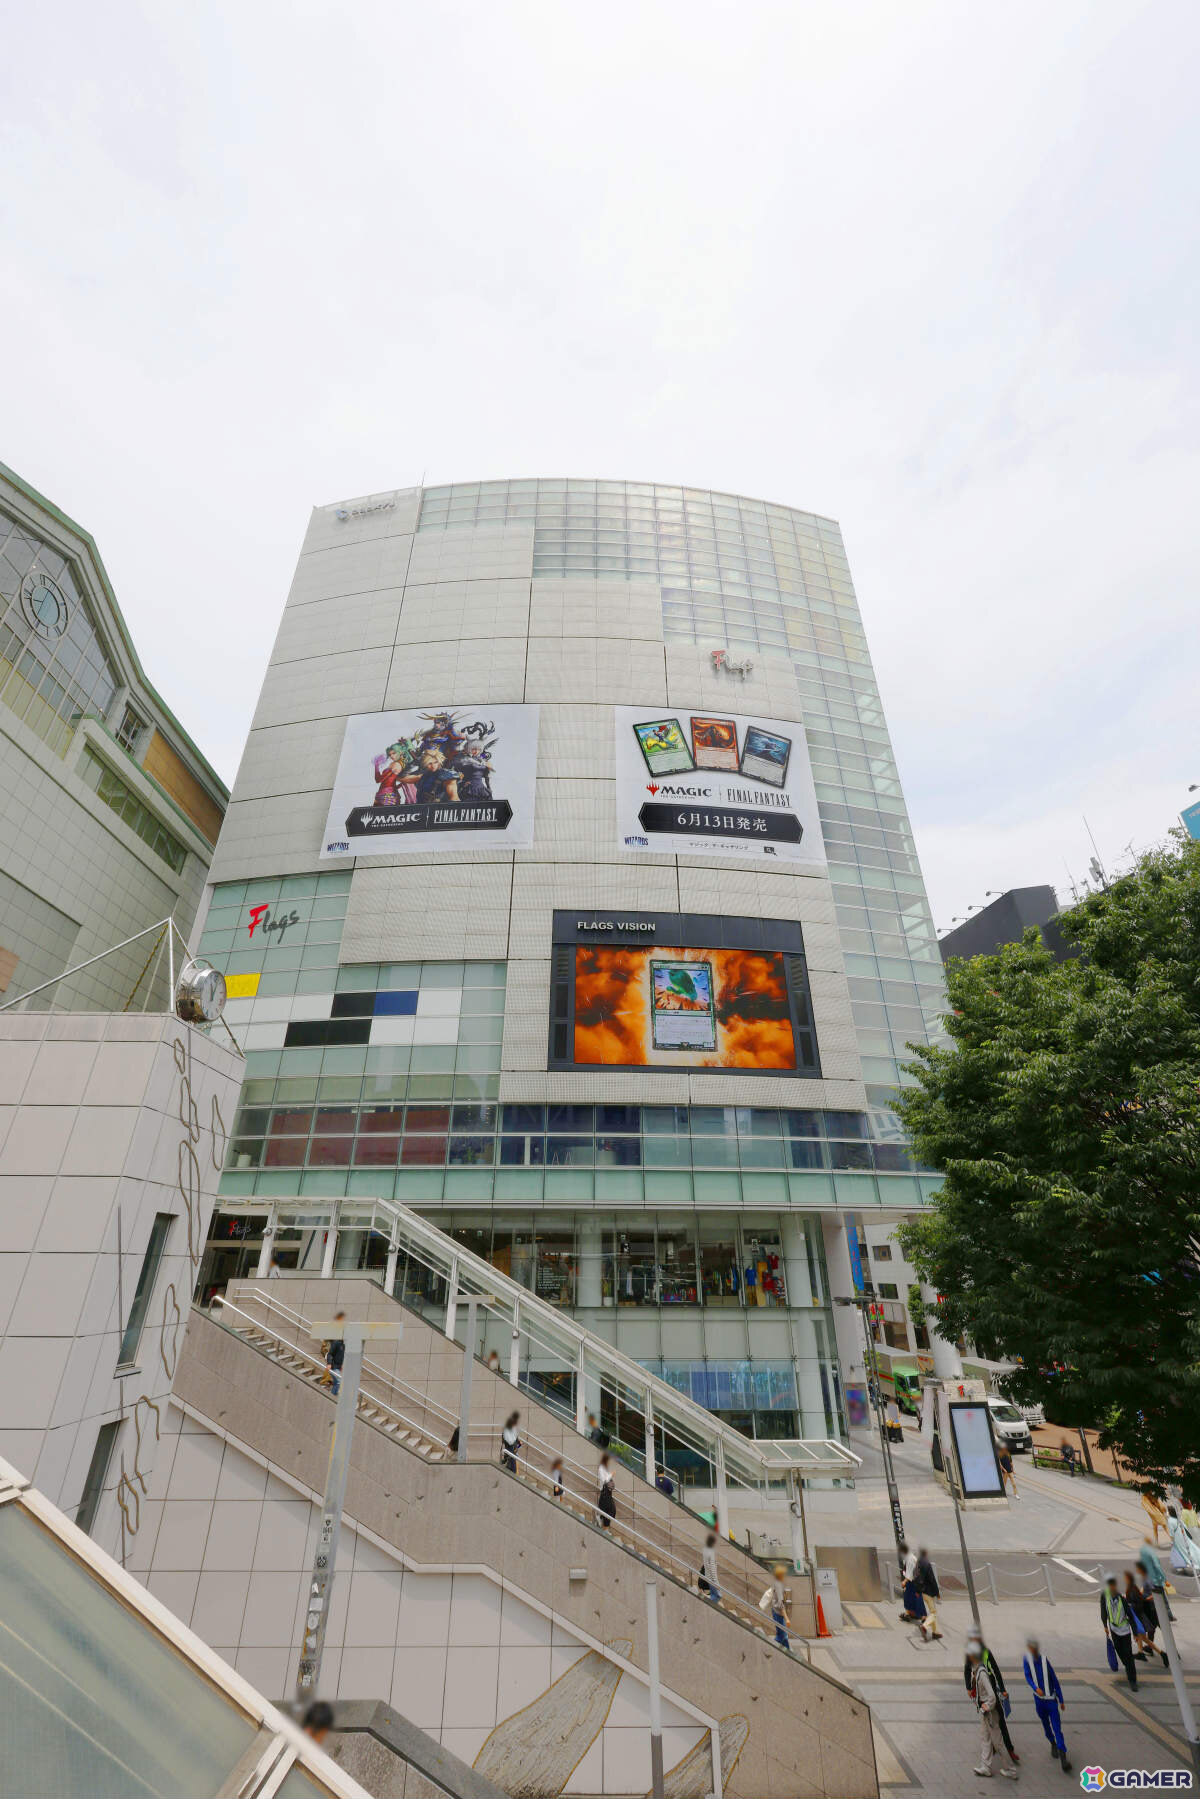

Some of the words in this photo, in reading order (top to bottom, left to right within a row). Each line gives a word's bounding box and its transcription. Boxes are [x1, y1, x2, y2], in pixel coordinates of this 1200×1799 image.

[660, 785, 712, 798] MAGIC
[727, 788, 753, 804] FINAL
[754, 791, 791, 807] FANTASY
[371, 813, 421, 825] MAGIC
[434, 809, 459, 823] FINAL
[460, 807, 498, 822] FANTASY
[677, 812, 768, 832] 6月13日発売
[248, 903, 300, 945] Flags
[577, 921, 614, 930] FLAGS
[617, 922, 656, 931] VISION
